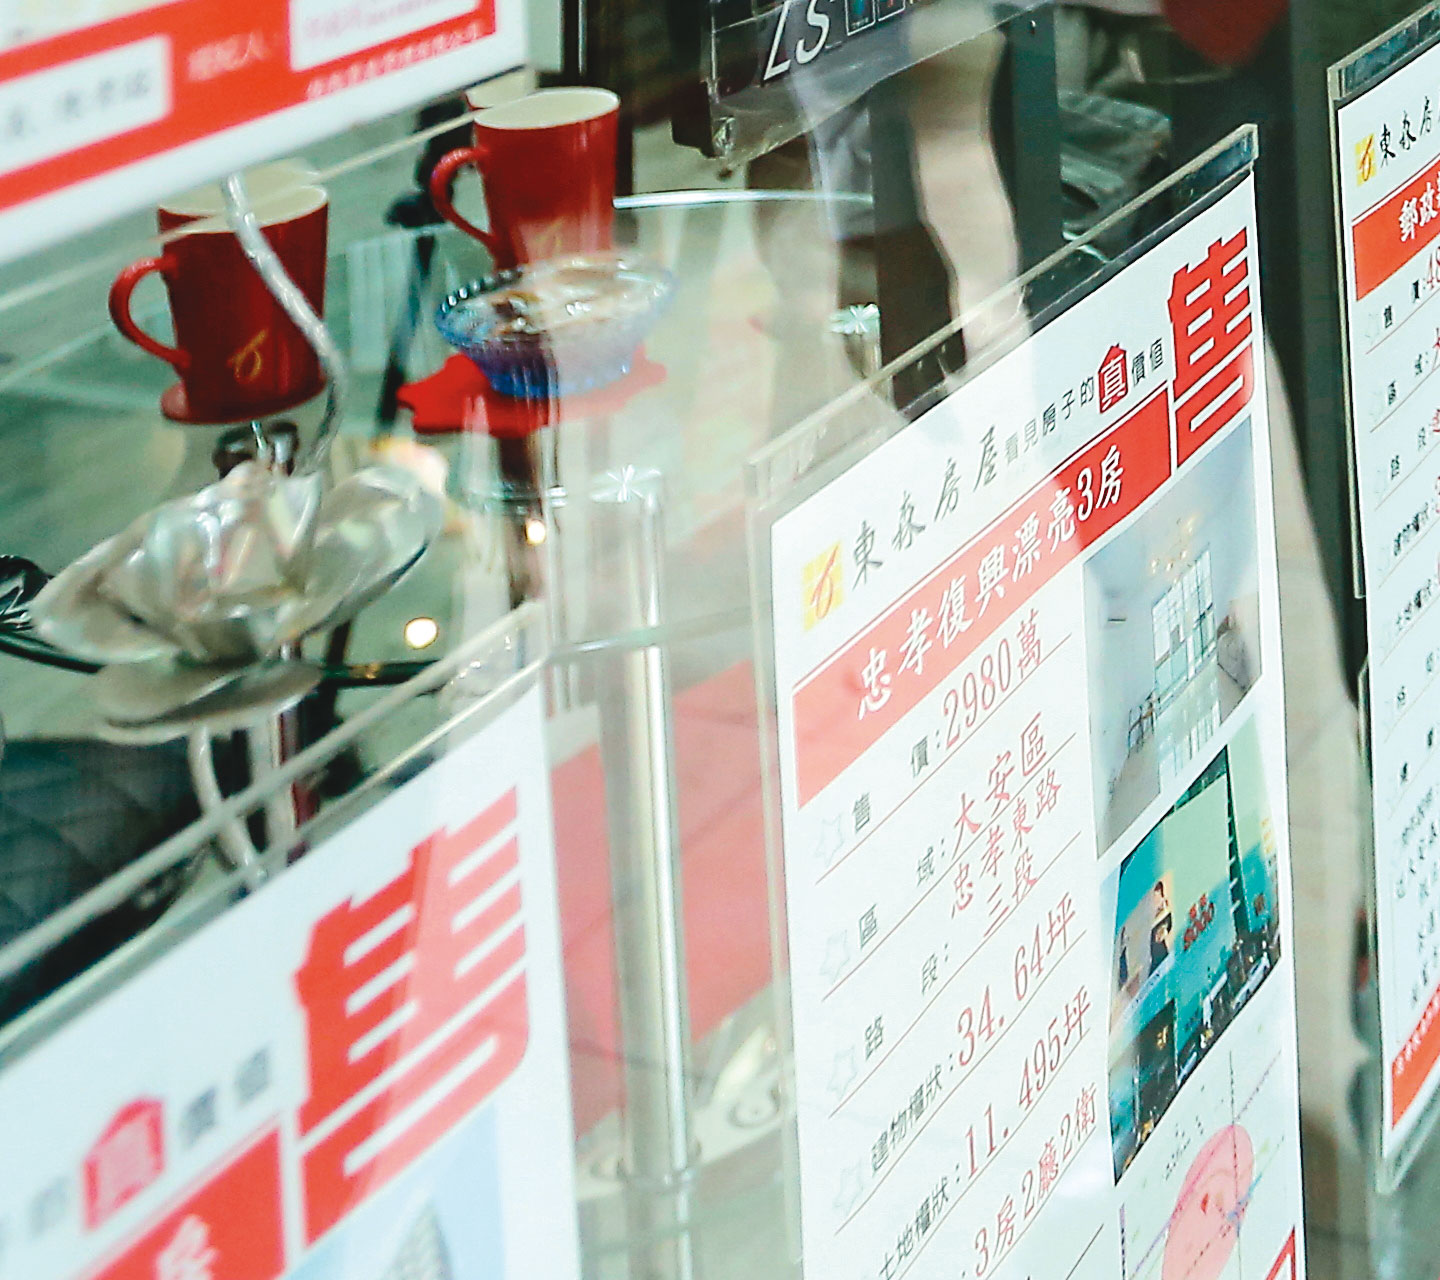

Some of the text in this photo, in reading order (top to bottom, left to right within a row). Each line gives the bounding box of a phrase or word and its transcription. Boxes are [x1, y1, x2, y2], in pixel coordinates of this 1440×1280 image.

[1166, 225, 1255, 470] 售
[850, 424, 999, 592] 東森房屋
[856, 442, 1126, 722] 忠孝復興漂亮3房
[852, 788, 871, 837] 售
[942, 603, 1042, 756] 2980萬
[858, 902, 878, 951] 區
[949, 707, 1047, 859] 大安區
[948, 754, 1062, 925] 忠孝東路
[292, 782, 531, 1251] 售
[864, 1011, 885, 1061] 路
[982, 840, 1036, 941] 三段
